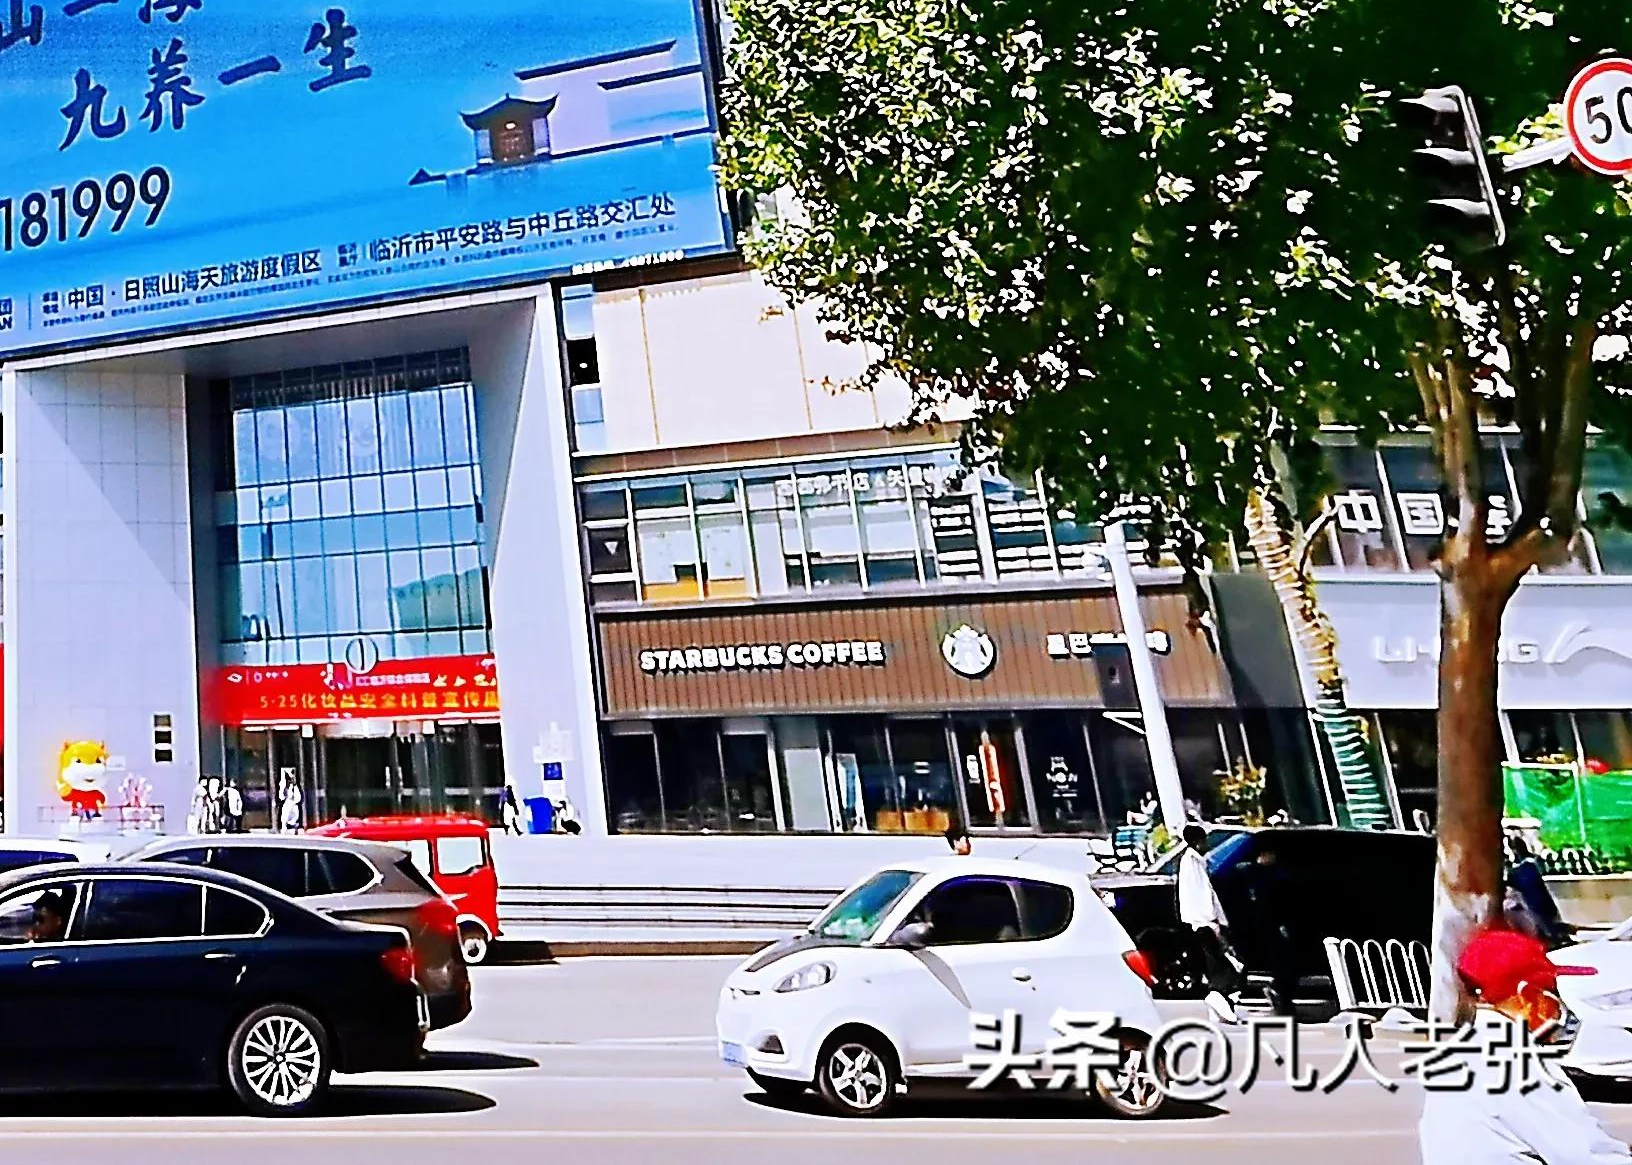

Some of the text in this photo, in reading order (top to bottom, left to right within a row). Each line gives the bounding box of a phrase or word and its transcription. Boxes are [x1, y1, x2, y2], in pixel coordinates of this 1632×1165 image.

[59, 8, 372, 151] 九养一生
[370, 192, 676, 261] 临沂市平安路与中丘路交汇处
[640, 641, 885, 672] STARBUCKS COFFEE
[1374, 636, 1540, 663] LI-G
